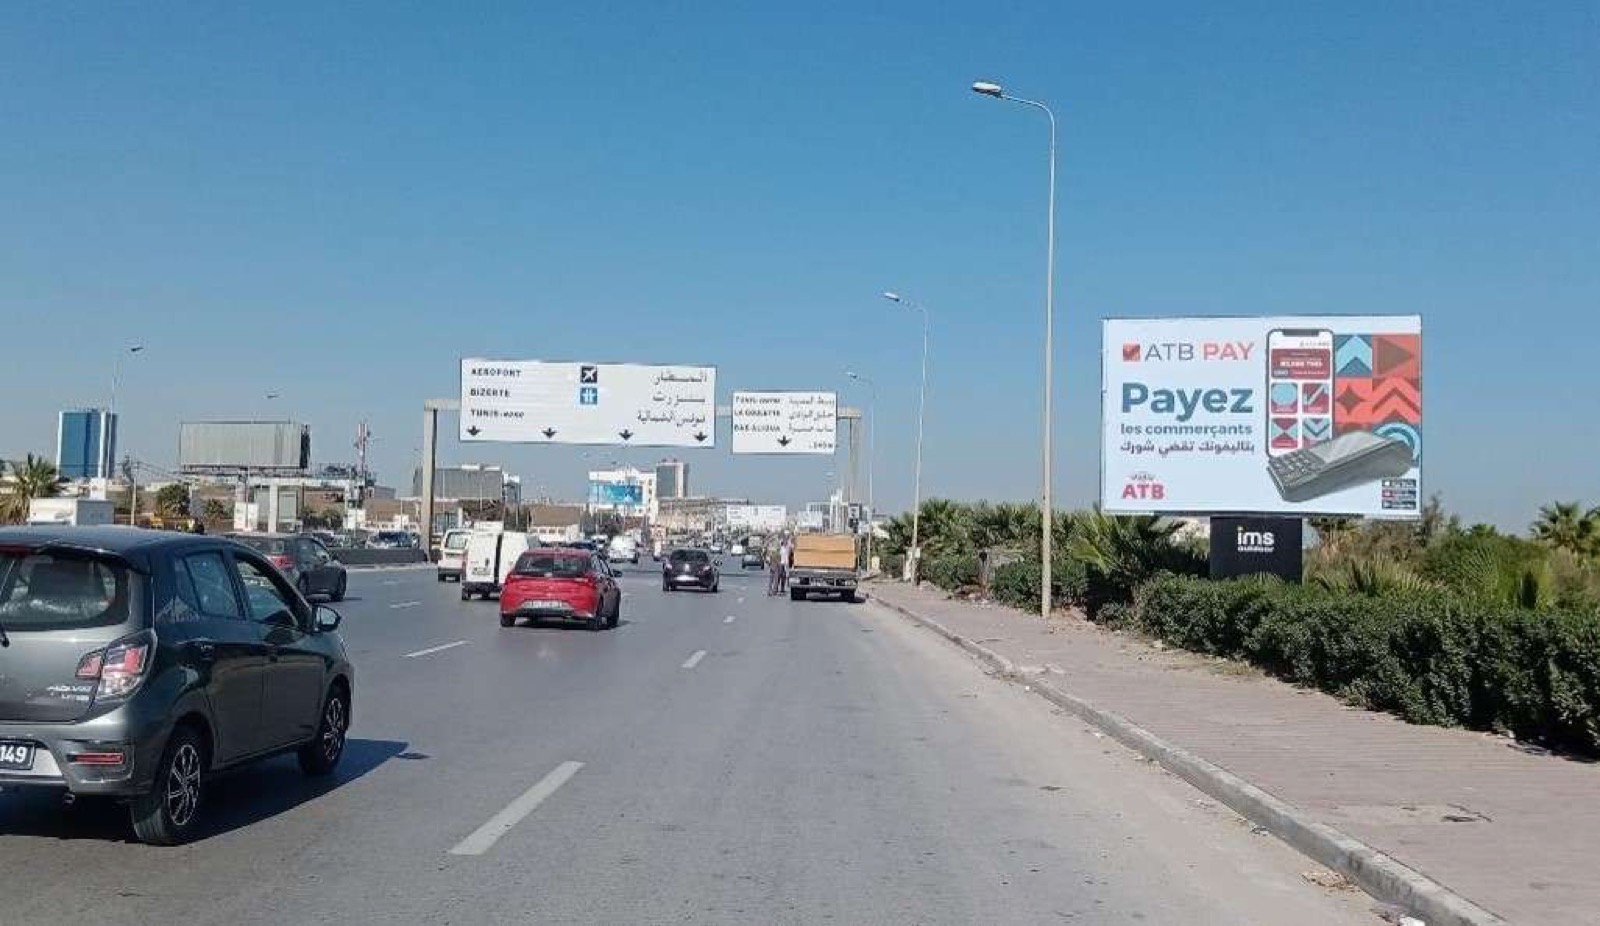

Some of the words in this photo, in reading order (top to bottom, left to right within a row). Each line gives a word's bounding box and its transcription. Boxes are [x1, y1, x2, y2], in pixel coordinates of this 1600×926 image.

[1144, 342, 1194, 361] ATB
[1203, 342, 1255, 361] PAY
[1122, 382, 1253, 422] Payez
[1121, 423, 1142, 435] les
[1145, 423, 1253, 438] commerçants
[1122, 483, 1165, 500] ATB
[1237, 526, 1275, 545] ims
[0, 746, 28, 763] 149
